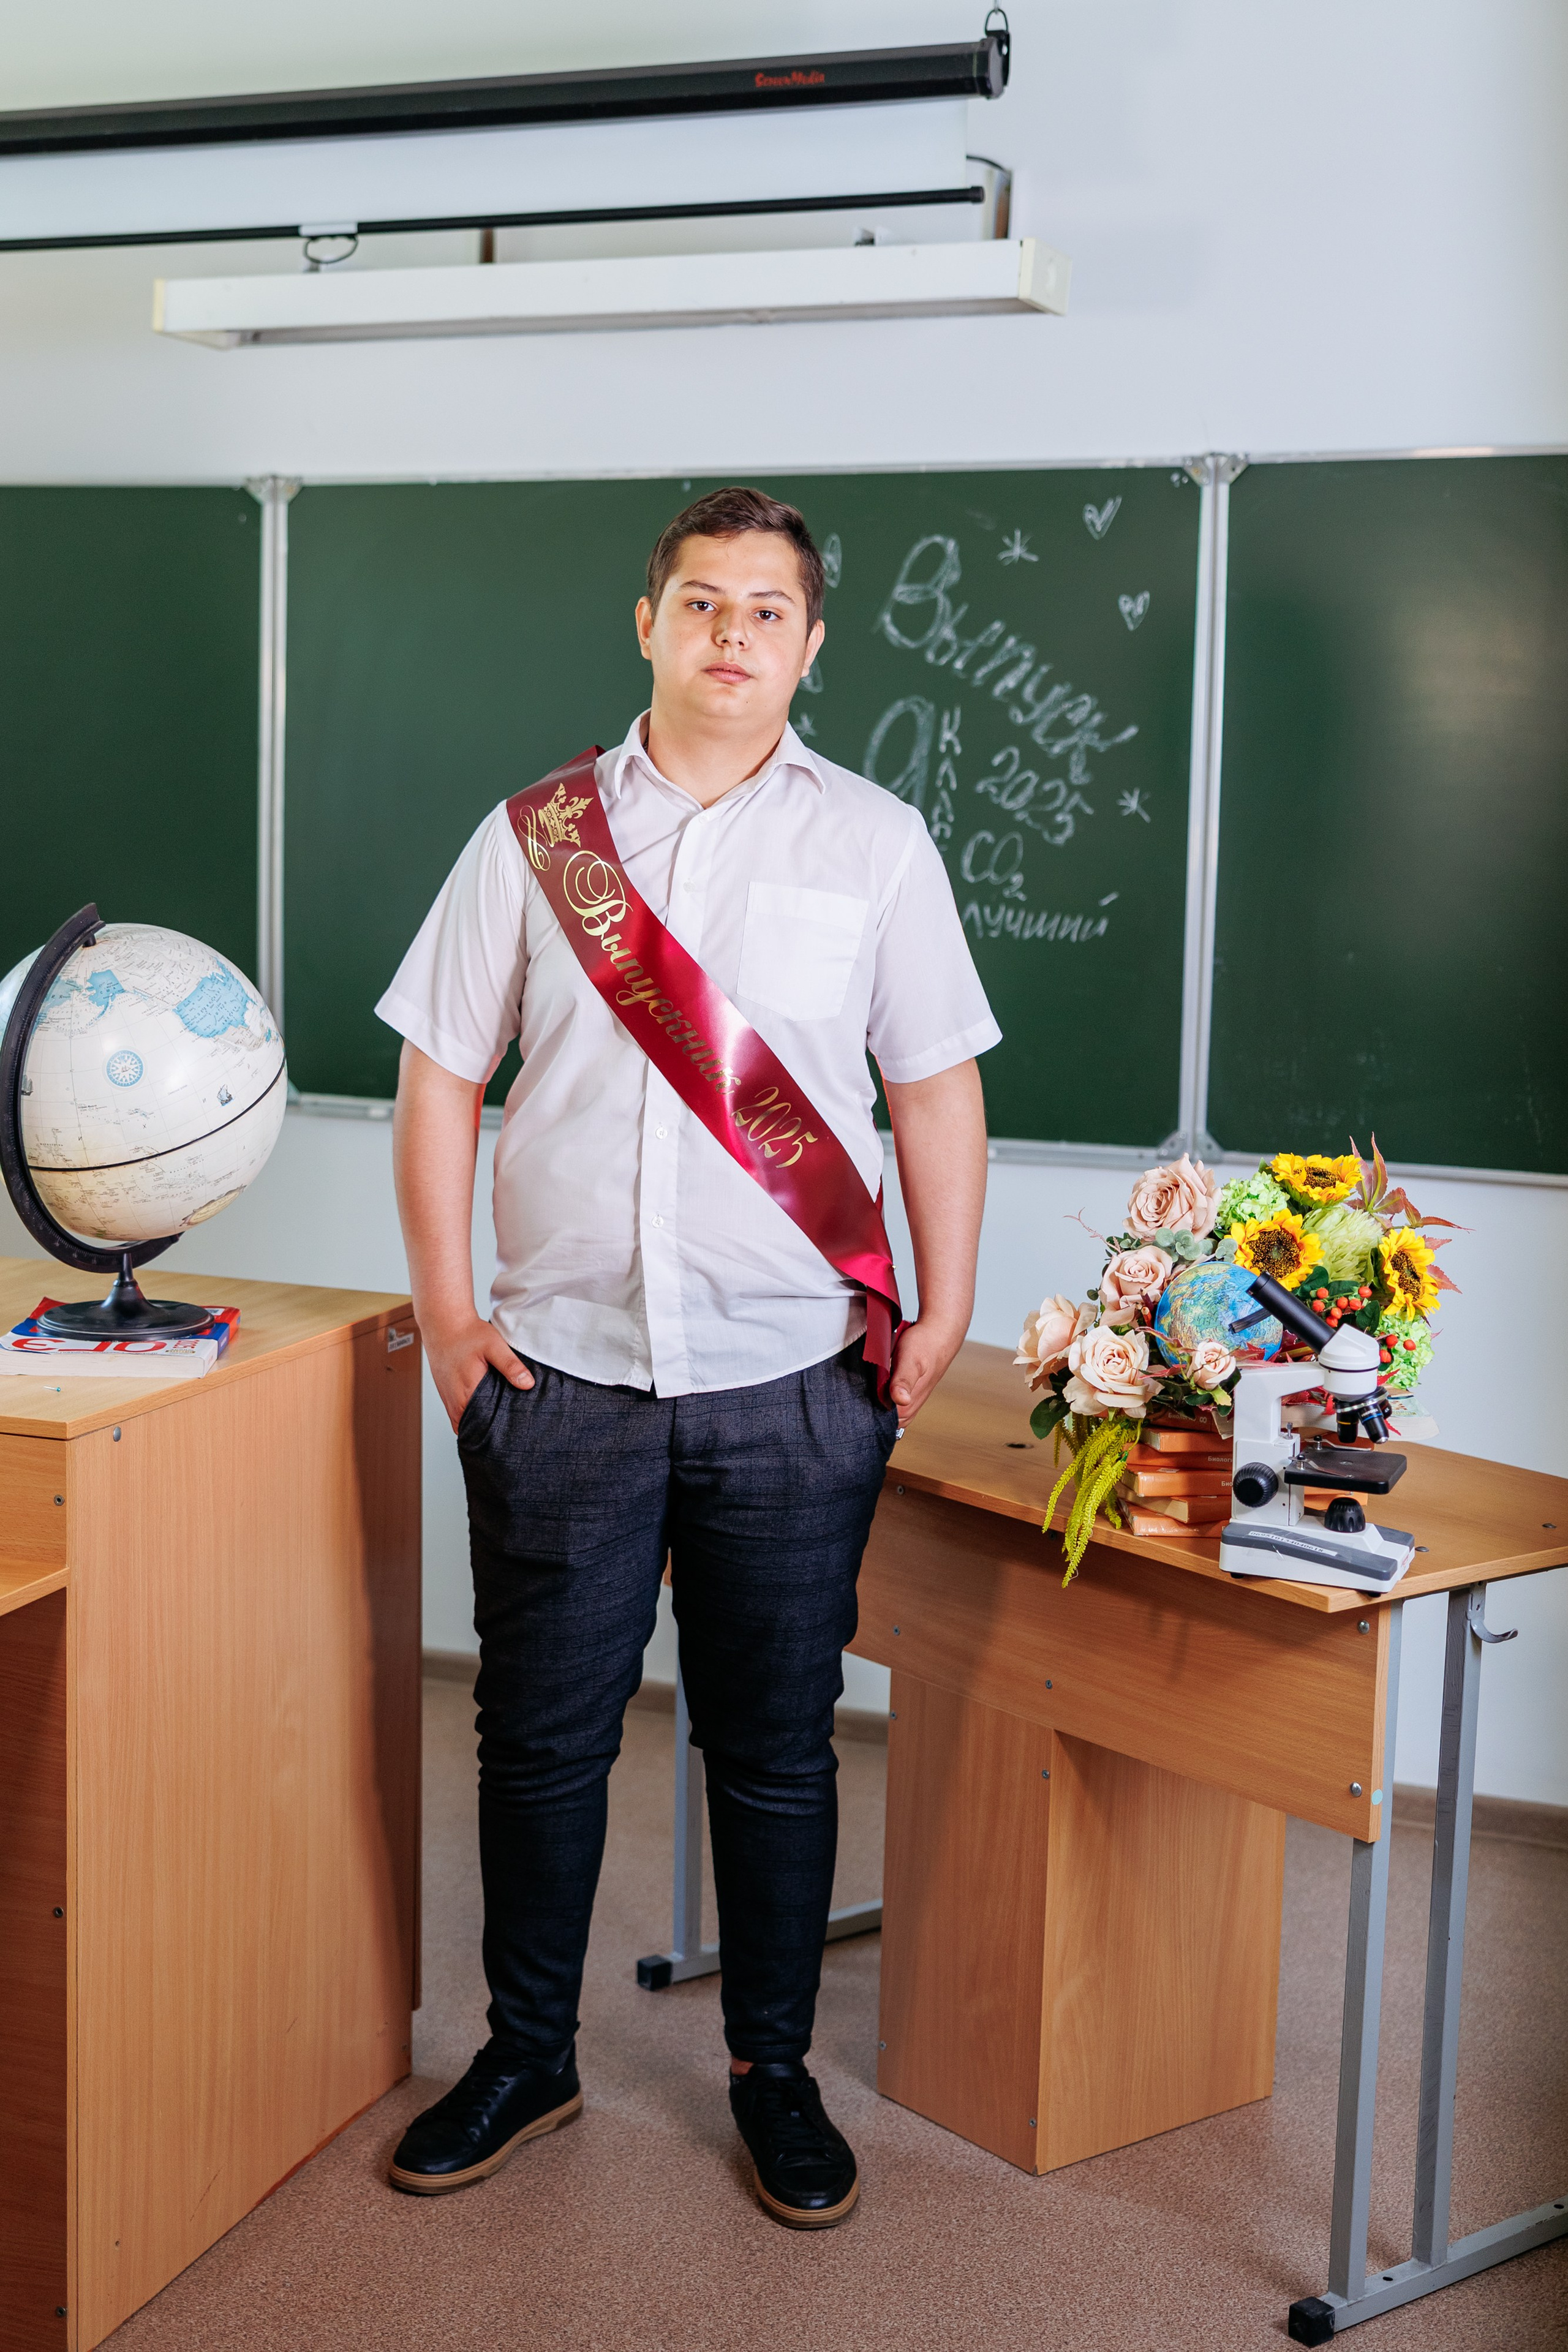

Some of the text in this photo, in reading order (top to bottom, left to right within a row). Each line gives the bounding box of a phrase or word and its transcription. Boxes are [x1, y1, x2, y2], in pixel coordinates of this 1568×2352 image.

[976, 746, 1095, 845] 2025
[563, 850, 818, 1169] Выпускник 2025
